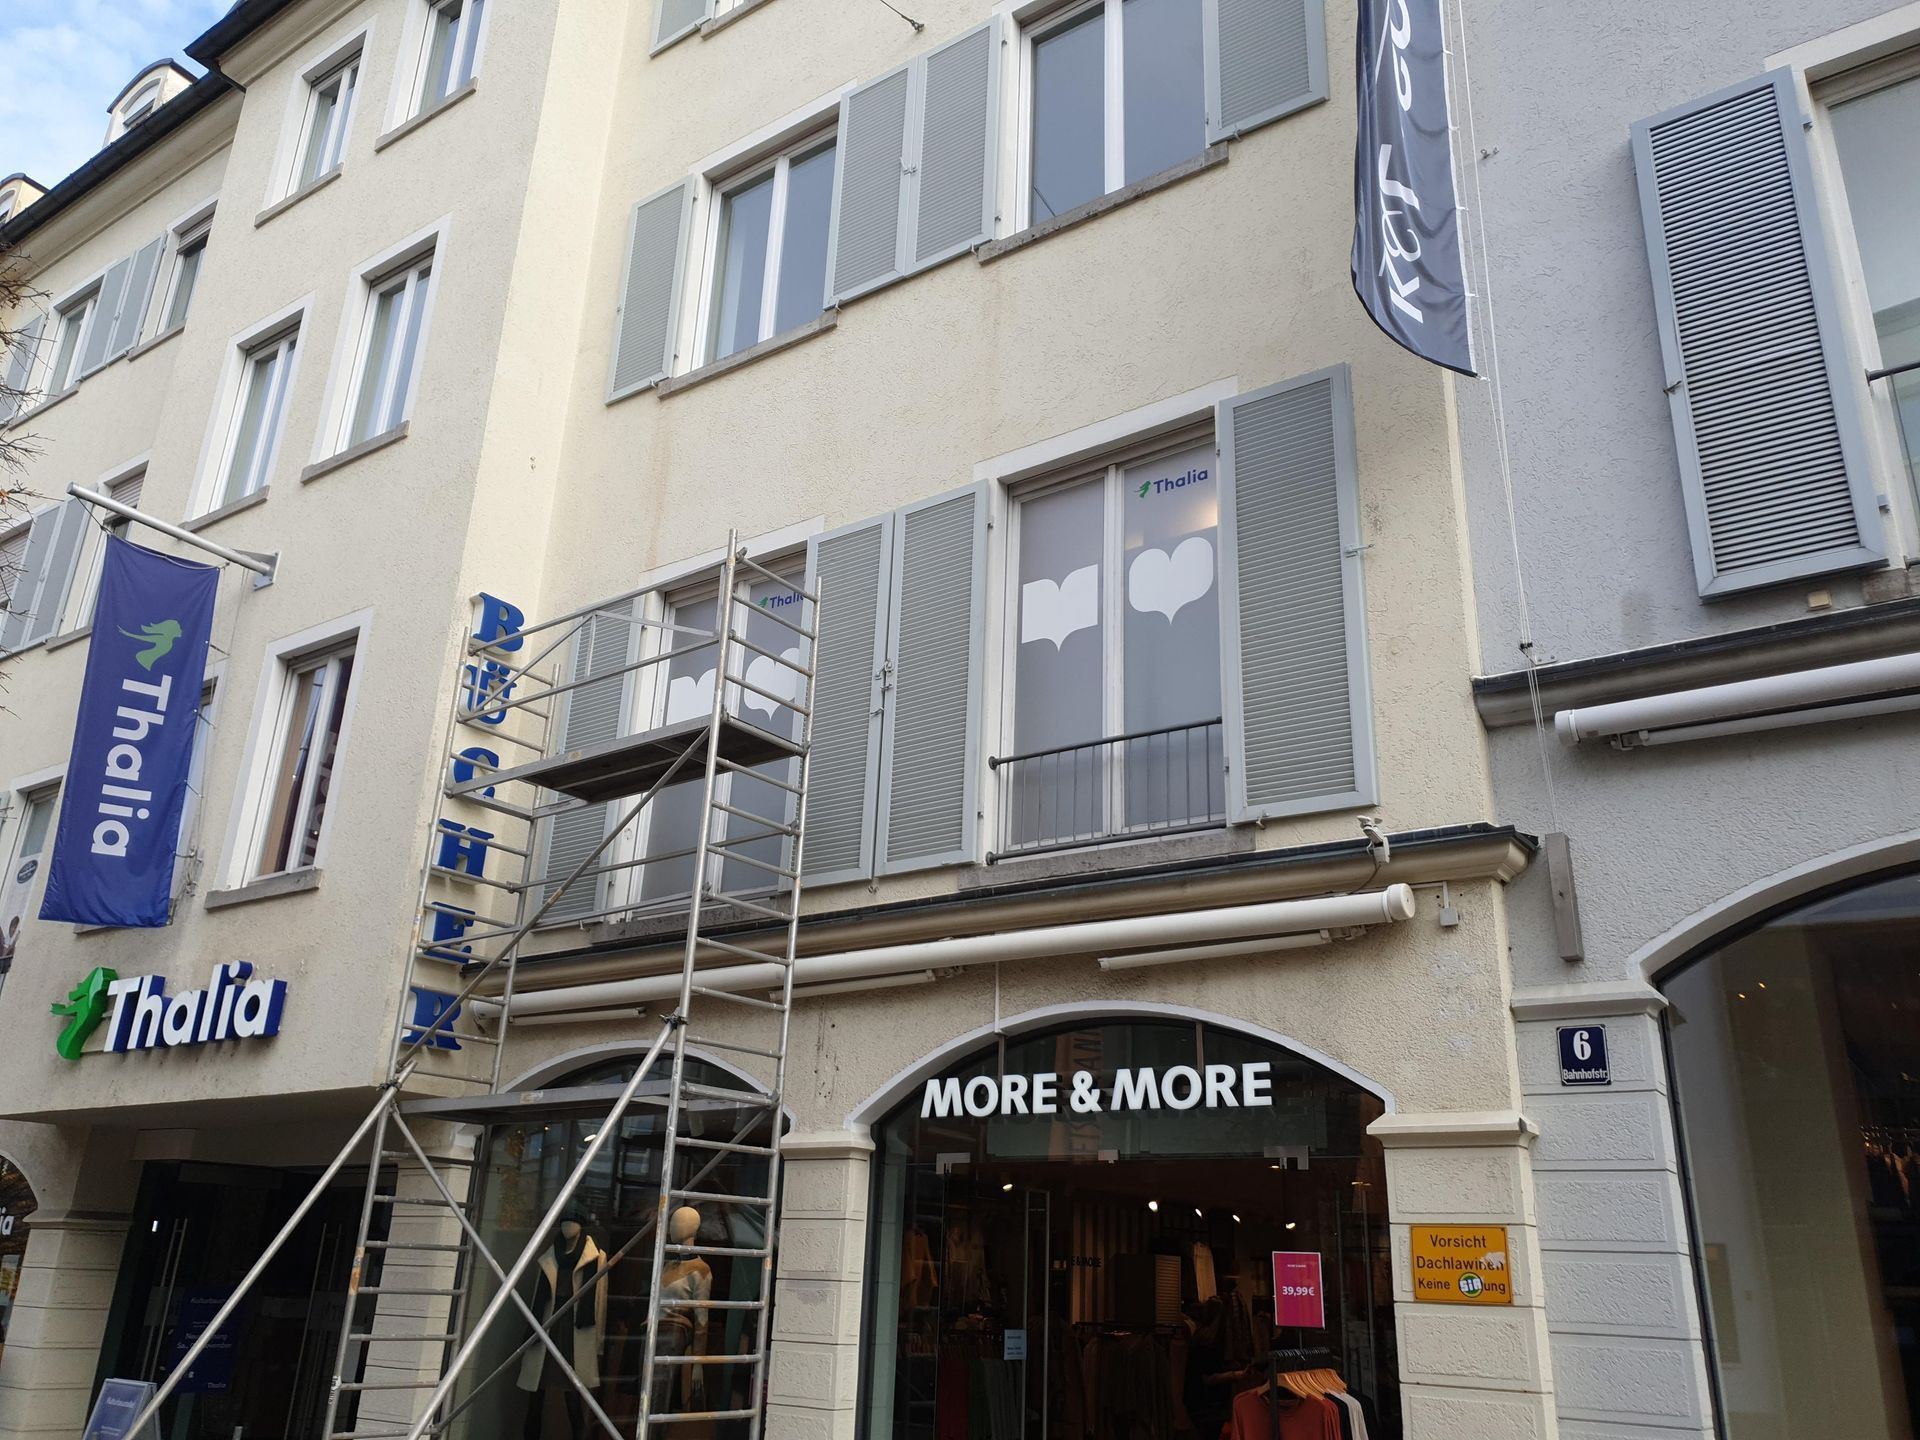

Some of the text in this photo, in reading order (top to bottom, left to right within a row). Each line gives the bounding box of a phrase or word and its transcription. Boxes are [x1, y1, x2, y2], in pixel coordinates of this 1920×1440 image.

[1152, 469, 1208, 494] Thalia
[91, 674, 172, 857] Thalia
[402, 591, 525, 1051] BÜCHER
[104, 960, 287, 1053] Thalia
[1573, 1030, 1592, 1060] 6
[1563, 1068, 1609, 1080] Bahnhofstr.
[920, 1062, 1274, 1119] MORE & MORE
[1430, 1234, 1487, 1249] Vorsicht
[1282, 1286, 1315, 1297] 39,99€
[1418, 1278, 1451, 1290] Keine
